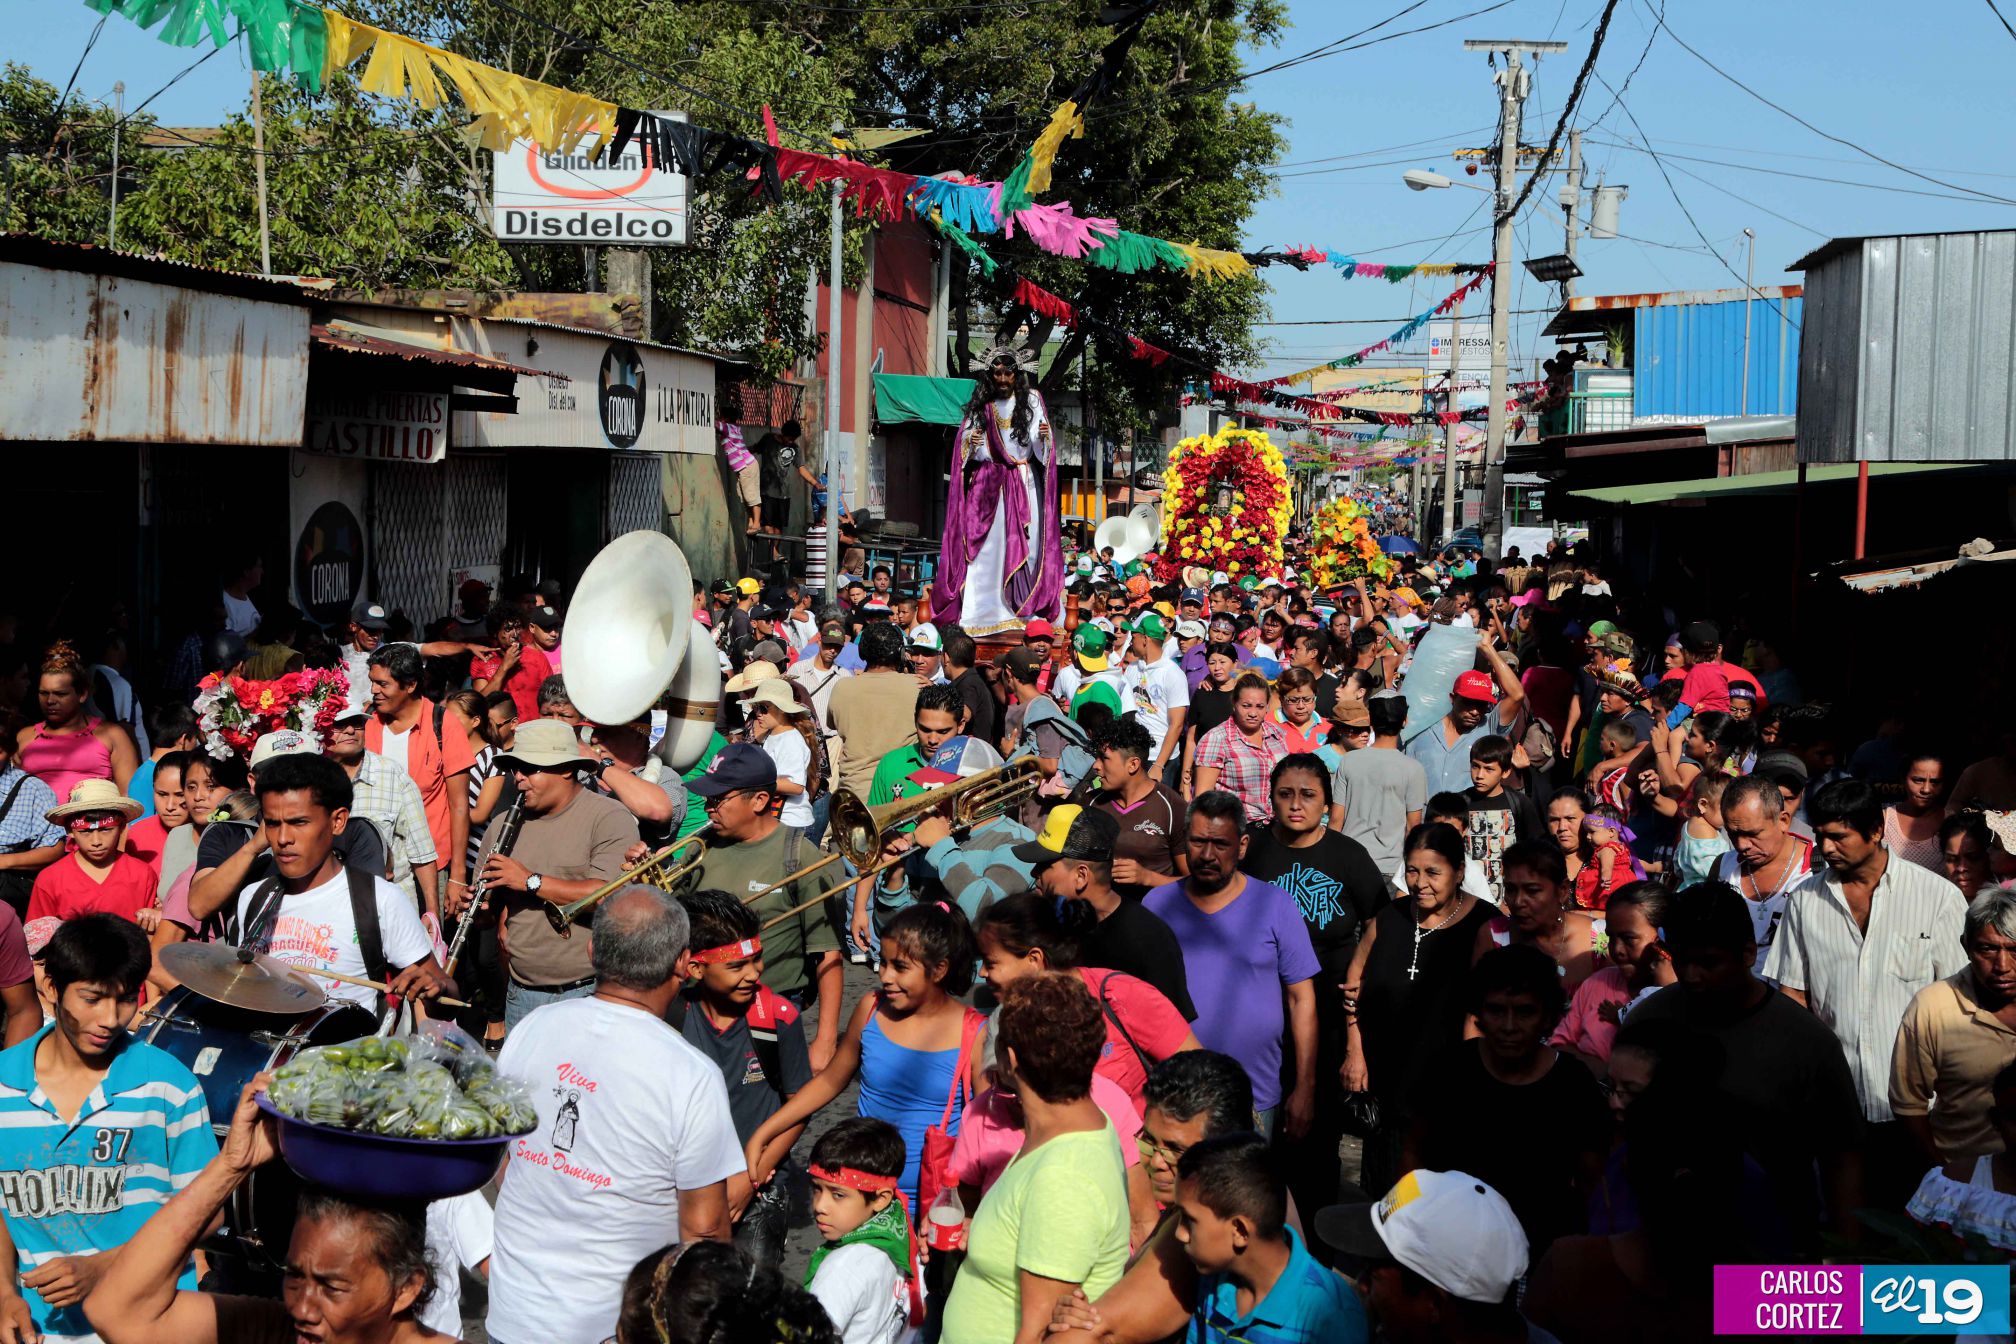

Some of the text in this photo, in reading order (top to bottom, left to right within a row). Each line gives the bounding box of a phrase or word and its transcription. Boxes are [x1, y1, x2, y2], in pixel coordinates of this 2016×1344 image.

[505, 211, 673, 238] Disdelco
[1440, 338, 1491, 347] IMRESSA
[1440, 347, 1491, 356] REESTOS
[376, 390, 443, 424] PUERTAS
[607, 395, 637, 437] CORONA
[676, 388, 712, 428] PINTURA
[311, 561, 350, 605] CORONA
[556, 1062, 599, 1093] Viva
[92, 1127, 133, 1162] 37
[516, 1139, 612, 1191] Santo Domingo
